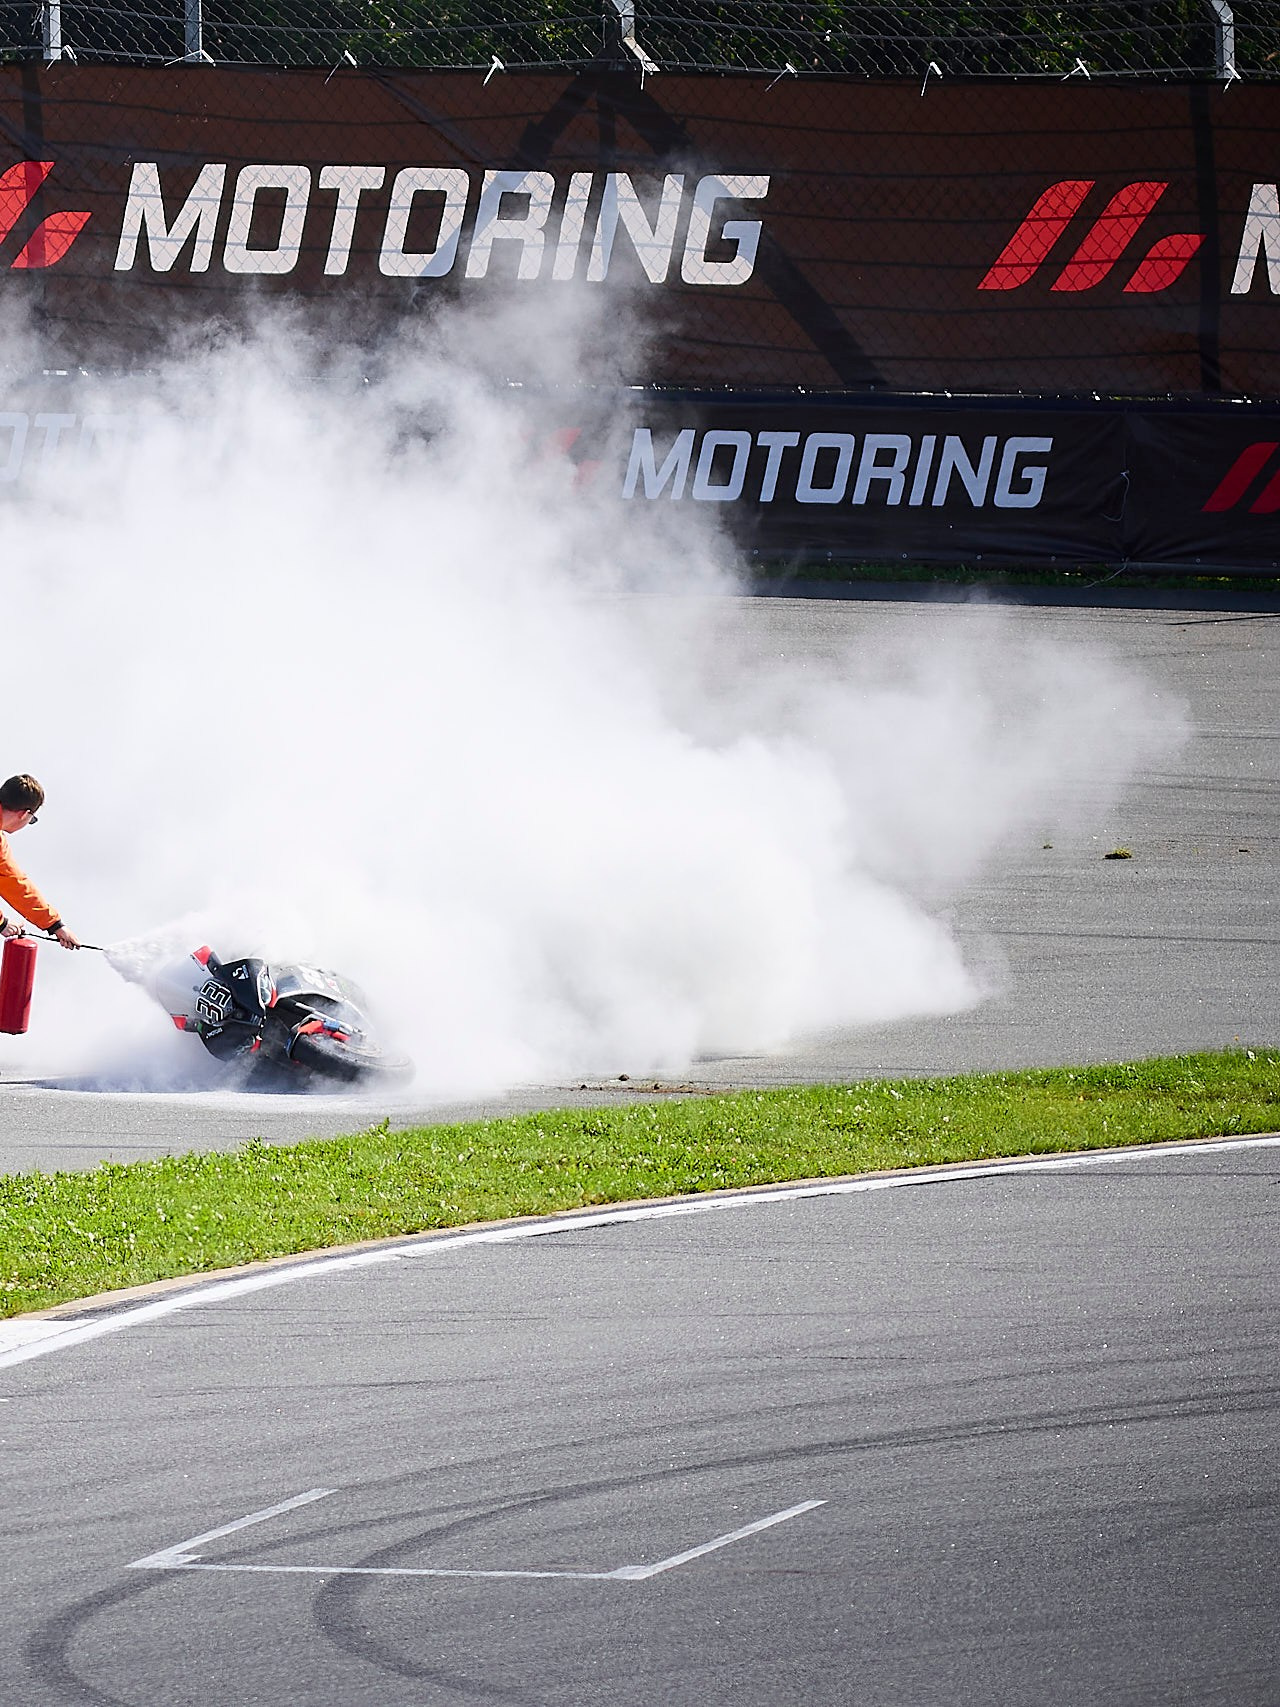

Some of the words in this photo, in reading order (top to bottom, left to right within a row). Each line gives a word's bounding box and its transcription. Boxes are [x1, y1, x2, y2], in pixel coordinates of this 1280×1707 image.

[113, 162, 771, 286] MOTORING
[621, 427, 1053, 509] MOTORING
[195, 979, 232, 1024] 33
